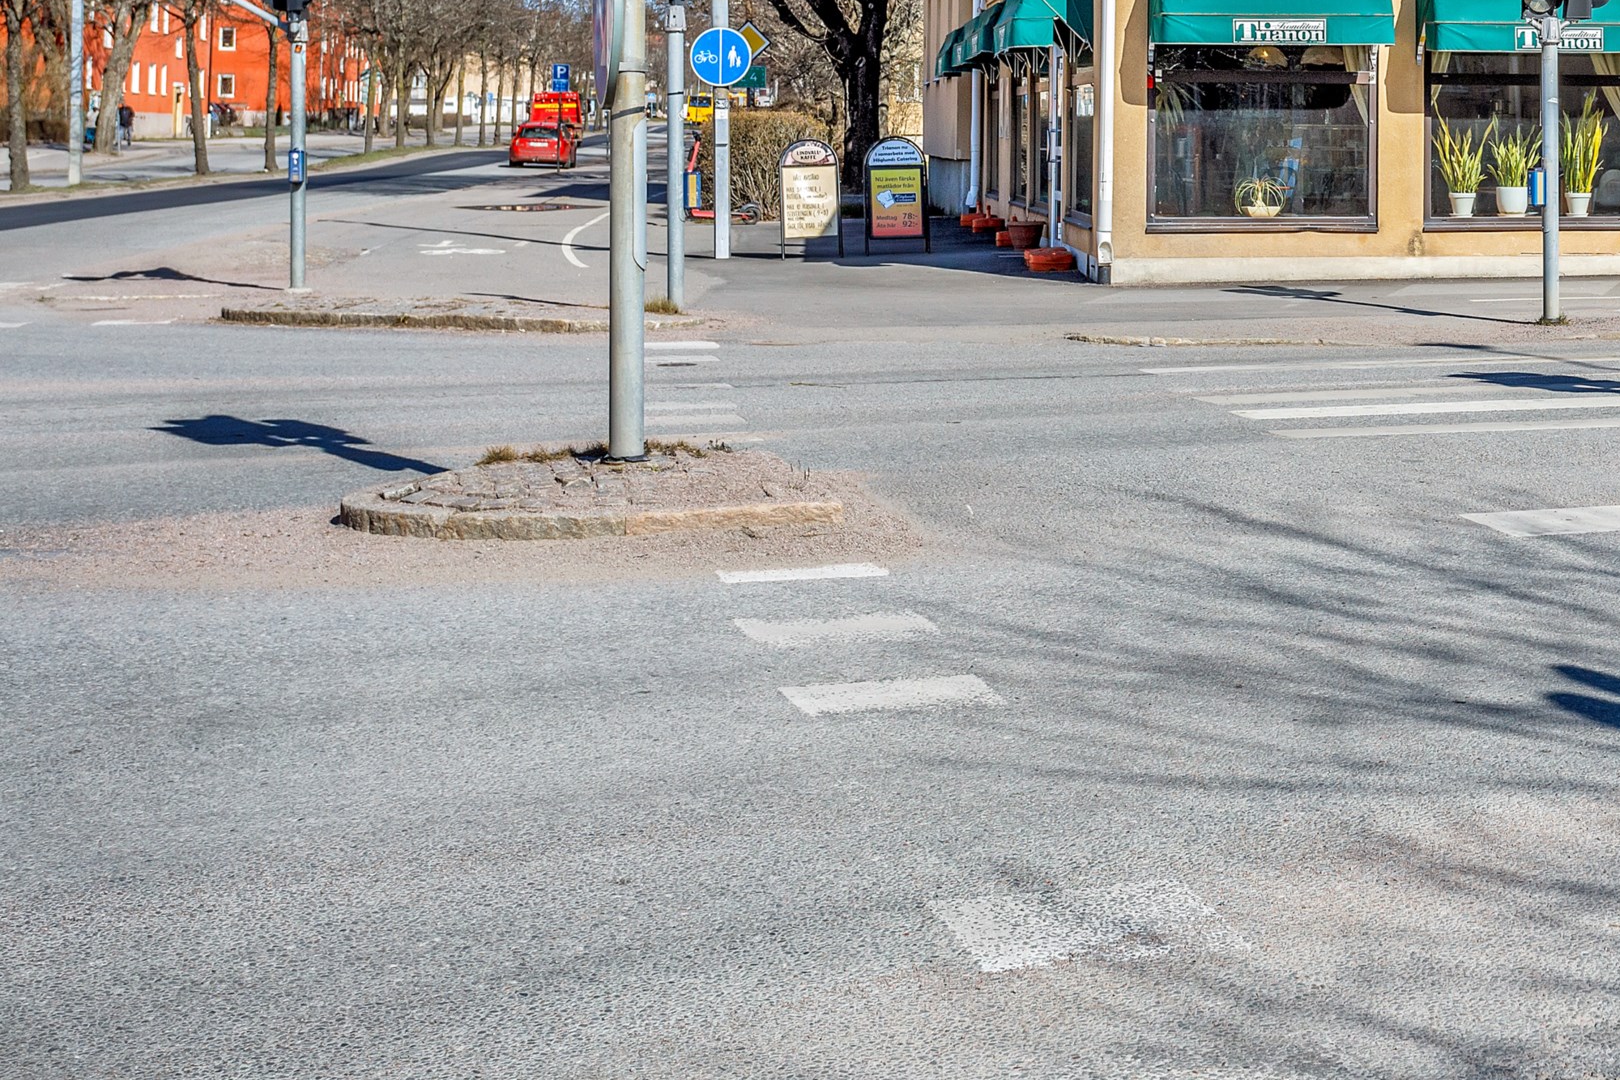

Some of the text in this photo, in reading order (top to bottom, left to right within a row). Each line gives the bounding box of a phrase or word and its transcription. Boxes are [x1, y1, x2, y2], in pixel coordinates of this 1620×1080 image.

[1235, 21, 1324, 41] Trianon
[1517, 29, 1602, 49] Tnon
[557, 66, 567, 79] P
